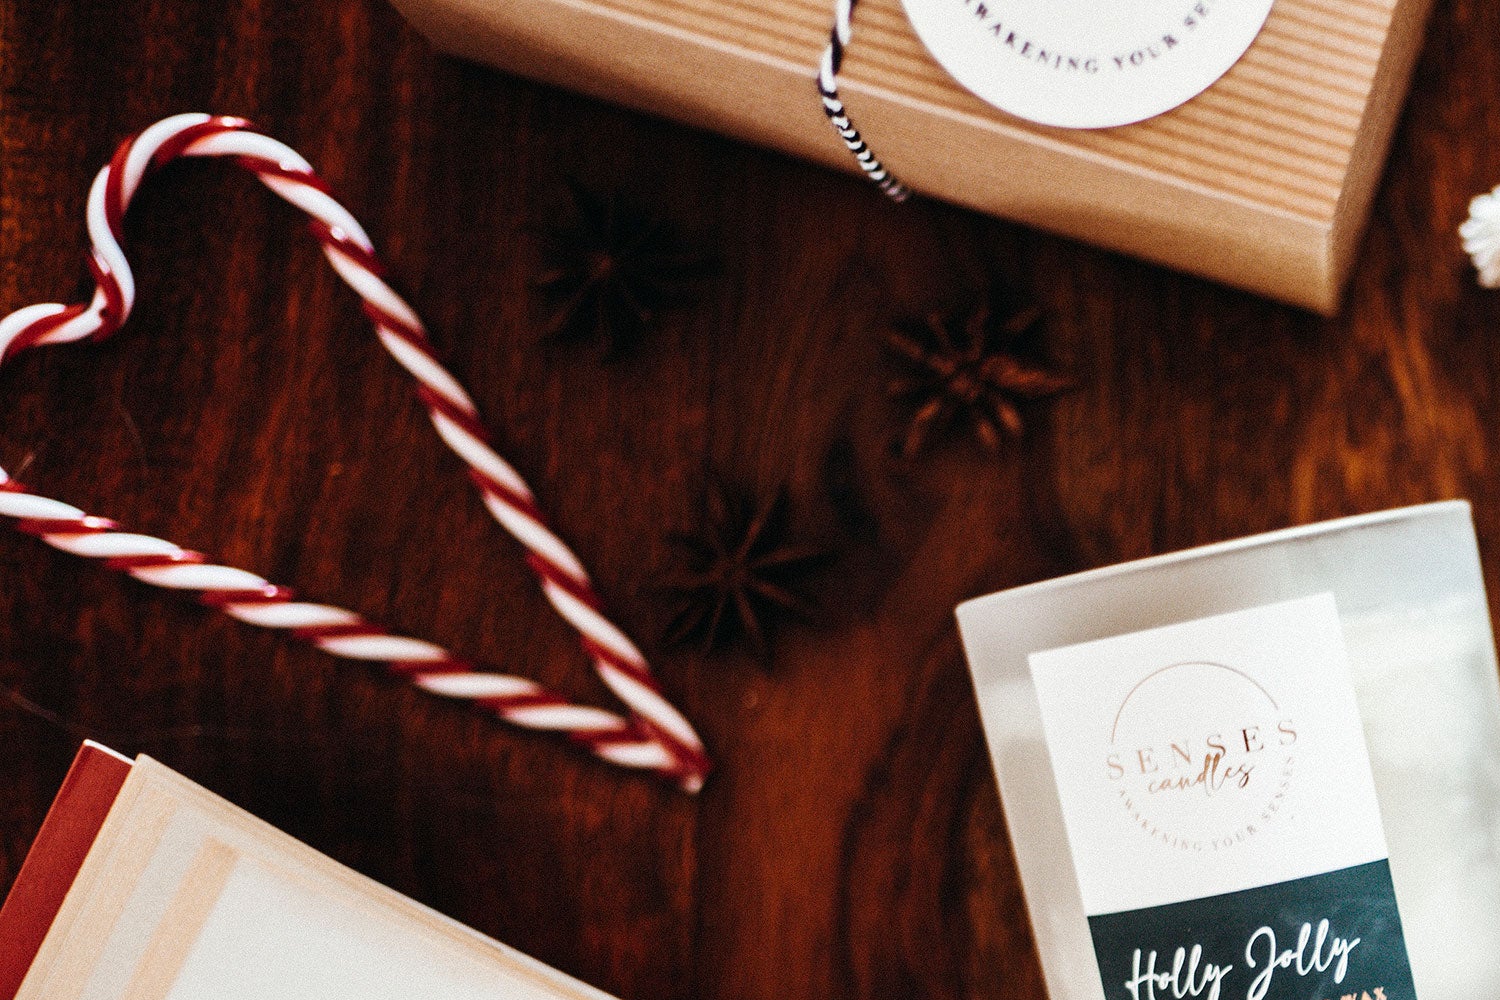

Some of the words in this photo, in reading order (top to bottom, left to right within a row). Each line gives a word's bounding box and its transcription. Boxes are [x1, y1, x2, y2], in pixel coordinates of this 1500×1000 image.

[965, 0, 1099, 74] WAKENING
[1113, 33, 1179, 71] YOUR
[1105, 718, 1298, 781] SENSES
[1147, 751, 1256, 797] candles
